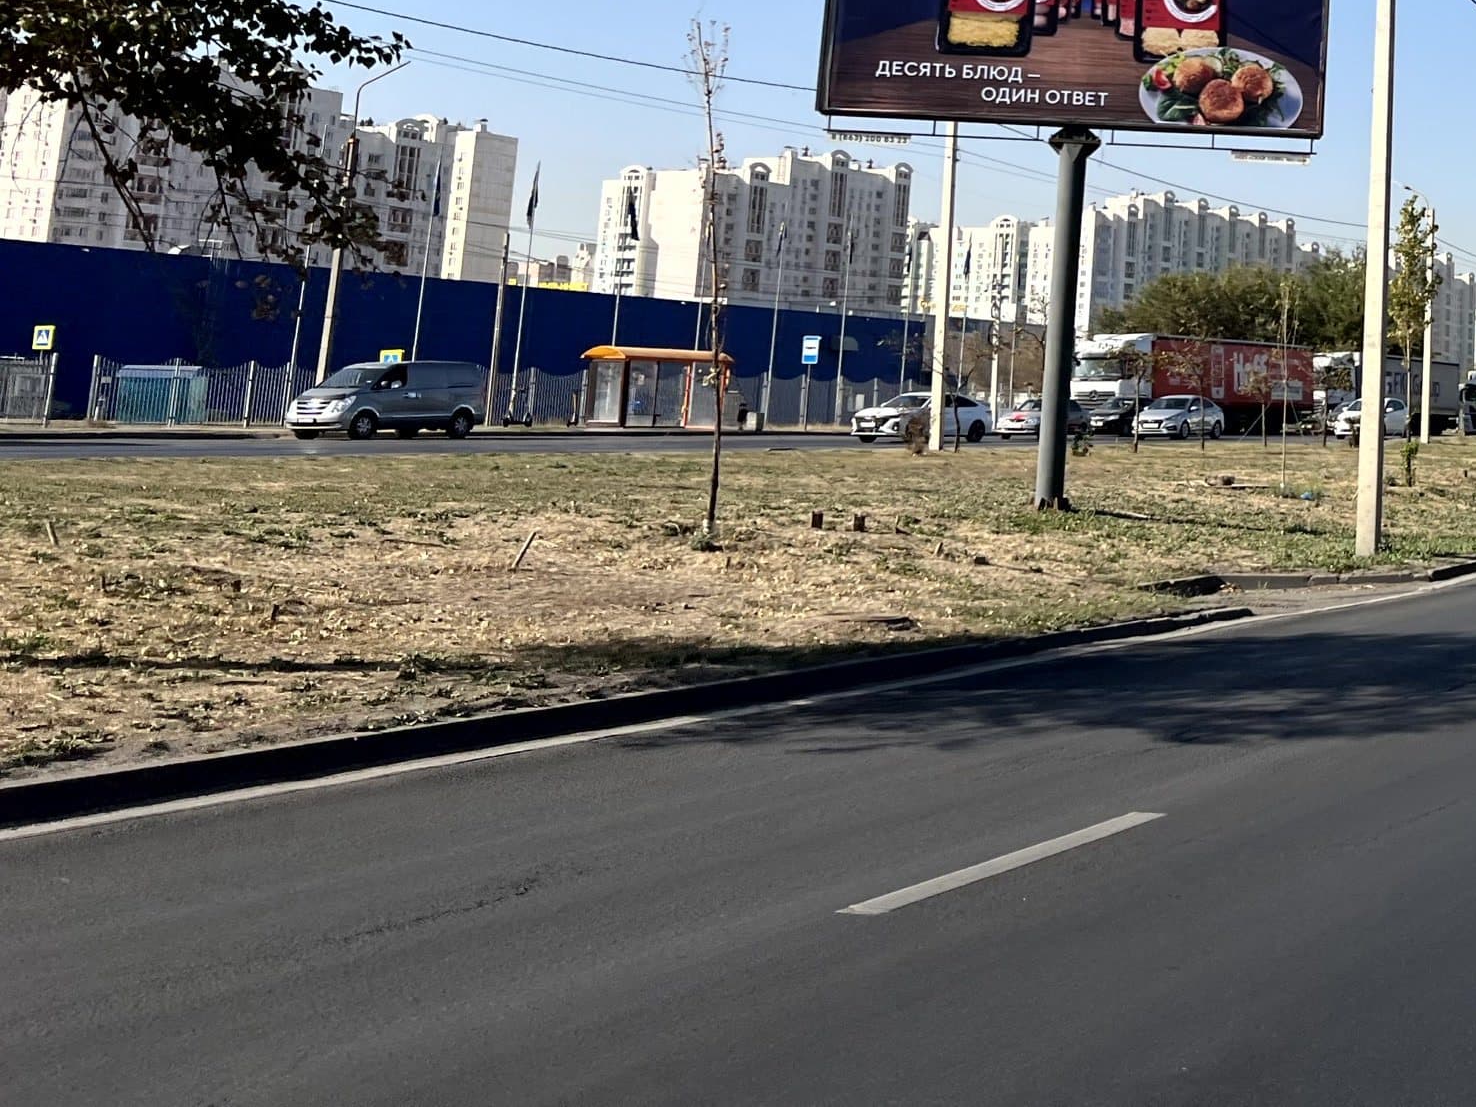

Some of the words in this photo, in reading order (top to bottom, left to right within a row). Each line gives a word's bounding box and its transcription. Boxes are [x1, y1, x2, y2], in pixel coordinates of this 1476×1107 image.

[875, 60, 956, 78] ДЕСЯТЬ
[962, 64, 1023, 83] БЛЮД
[981, 87, 1040, 105] ОДИН
[1045, 90, 1109, 107] ОТВЕТ
